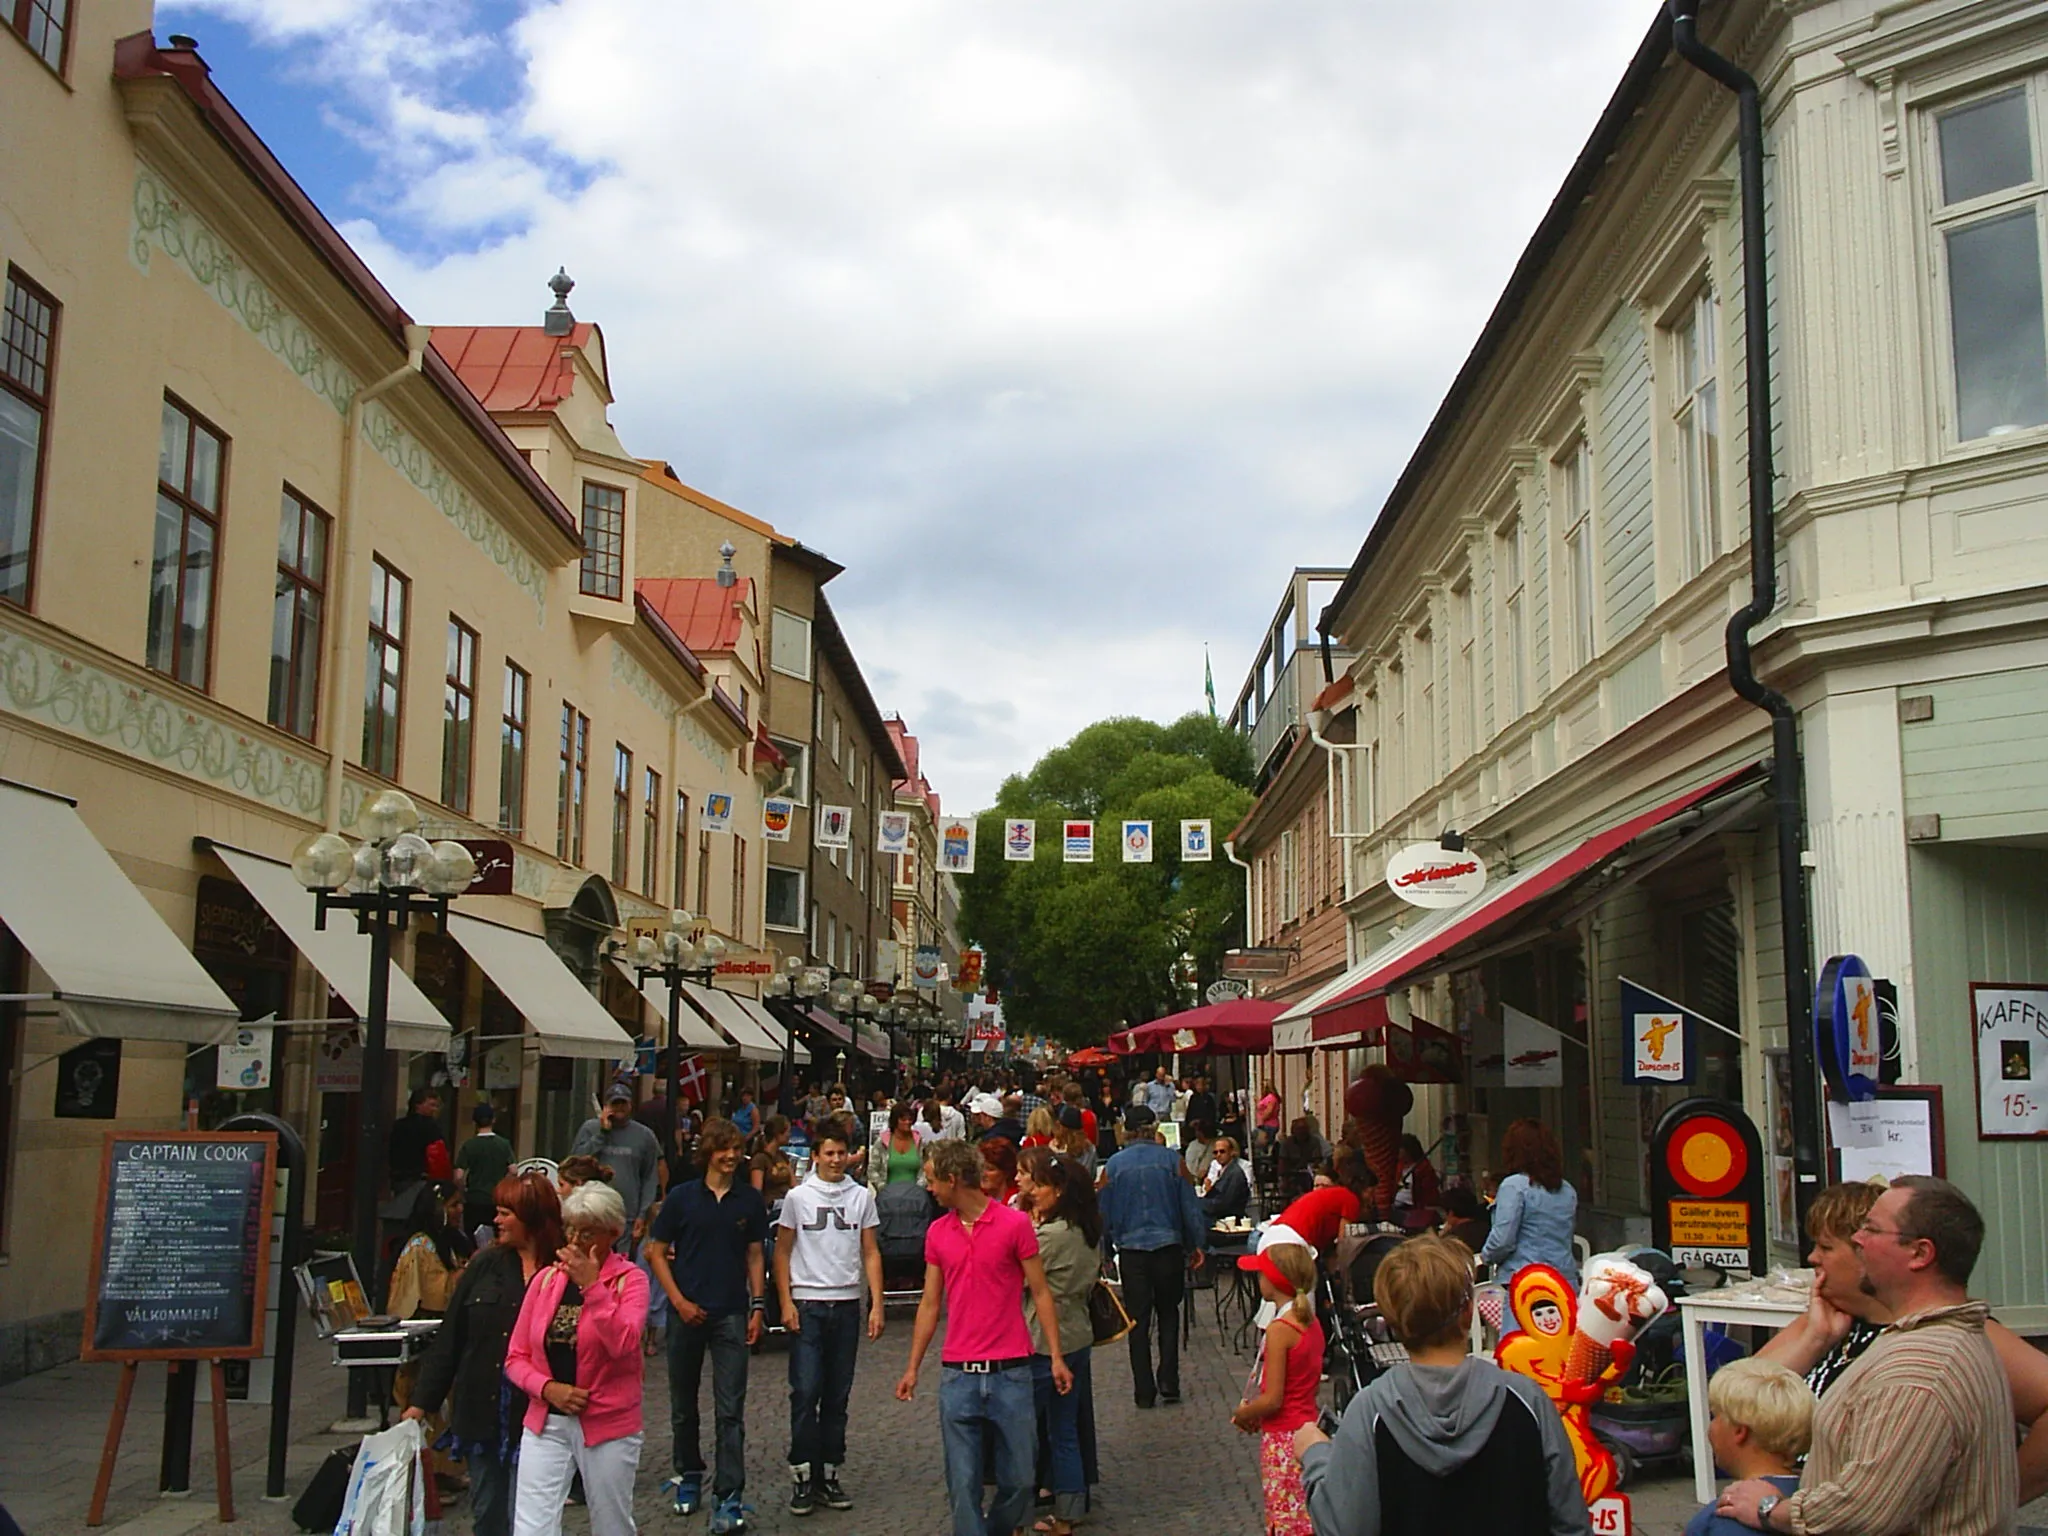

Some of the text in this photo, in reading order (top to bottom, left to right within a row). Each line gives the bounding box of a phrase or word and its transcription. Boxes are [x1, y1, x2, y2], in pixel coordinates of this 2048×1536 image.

[1979, 999, 2048, 1039] KAFFE
[129, 1145, 249, 1161] CAPTAIN COOK
